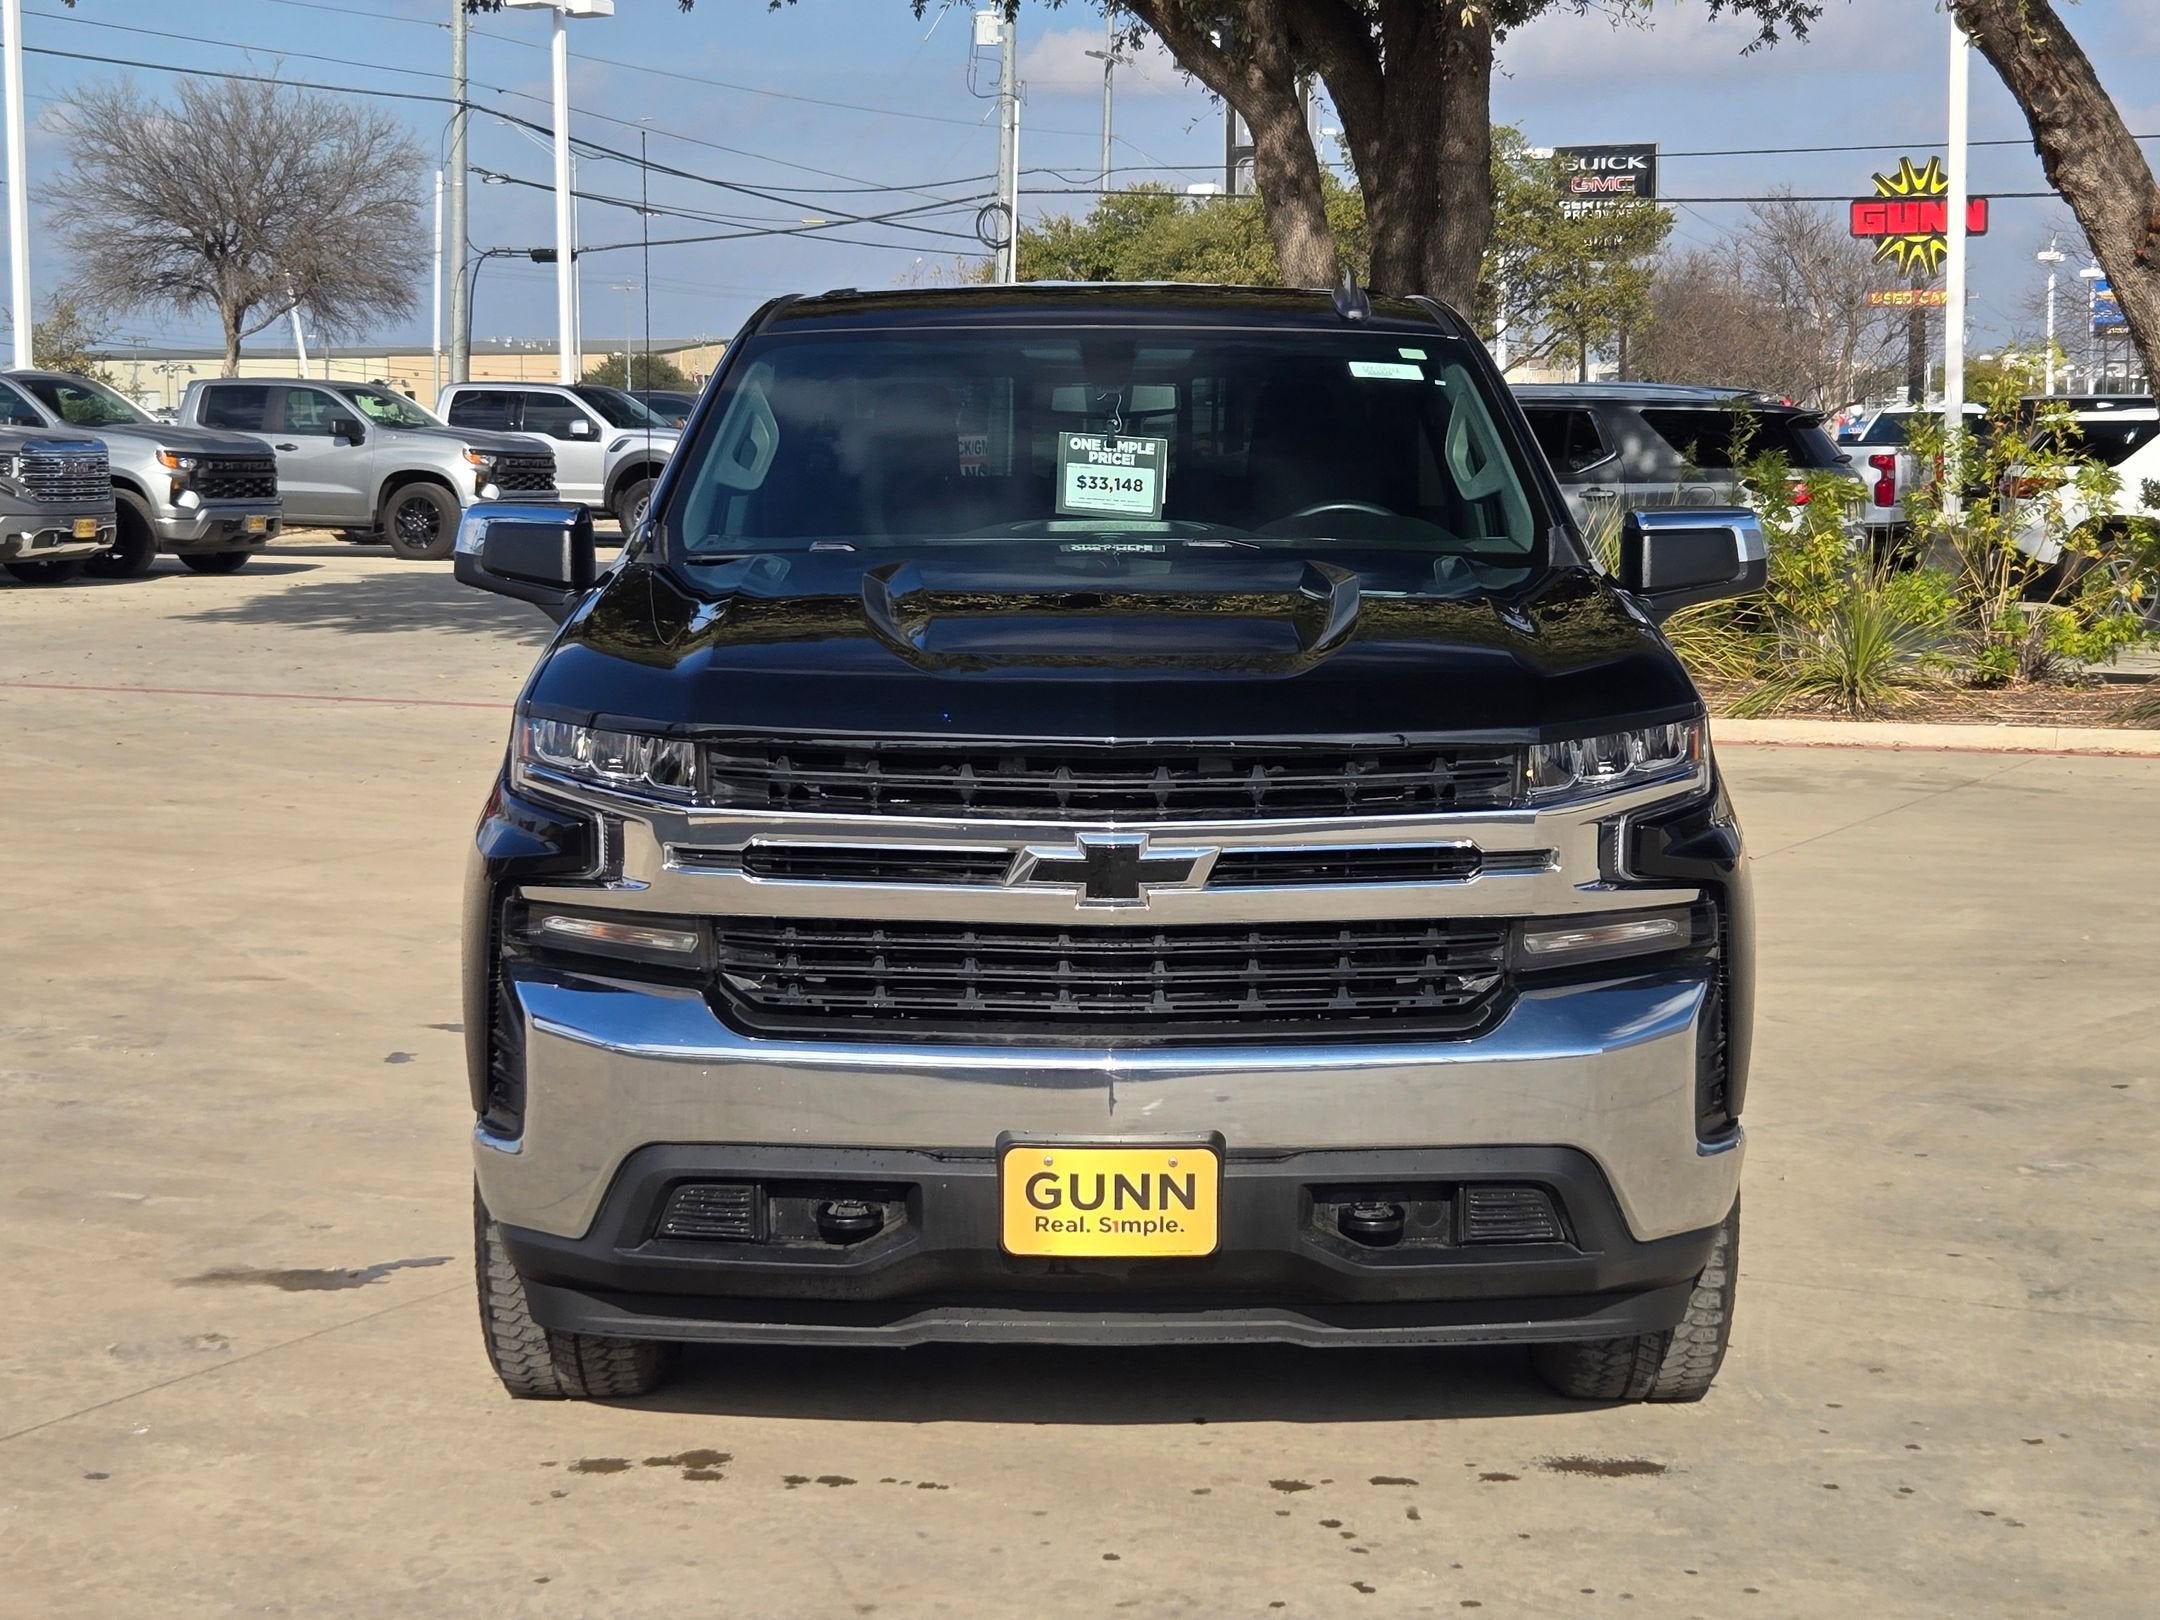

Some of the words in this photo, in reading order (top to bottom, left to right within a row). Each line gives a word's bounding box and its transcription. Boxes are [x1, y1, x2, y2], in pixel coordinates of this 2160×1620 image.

[1571, 175, 1635, 193] GMC
[1852, 199, 1985, 235] GUNN
[1871, 291, 1913, 305] USED
[1069, 437, 1102, 452] ONE
[1103, 439, 1156, 455] SMPLE
[1076, 474, 1144, 493] $33,148
[1025, 1171, 1196, 1211] GUNN
[1035, 1216, 1091, 1233] Real.
